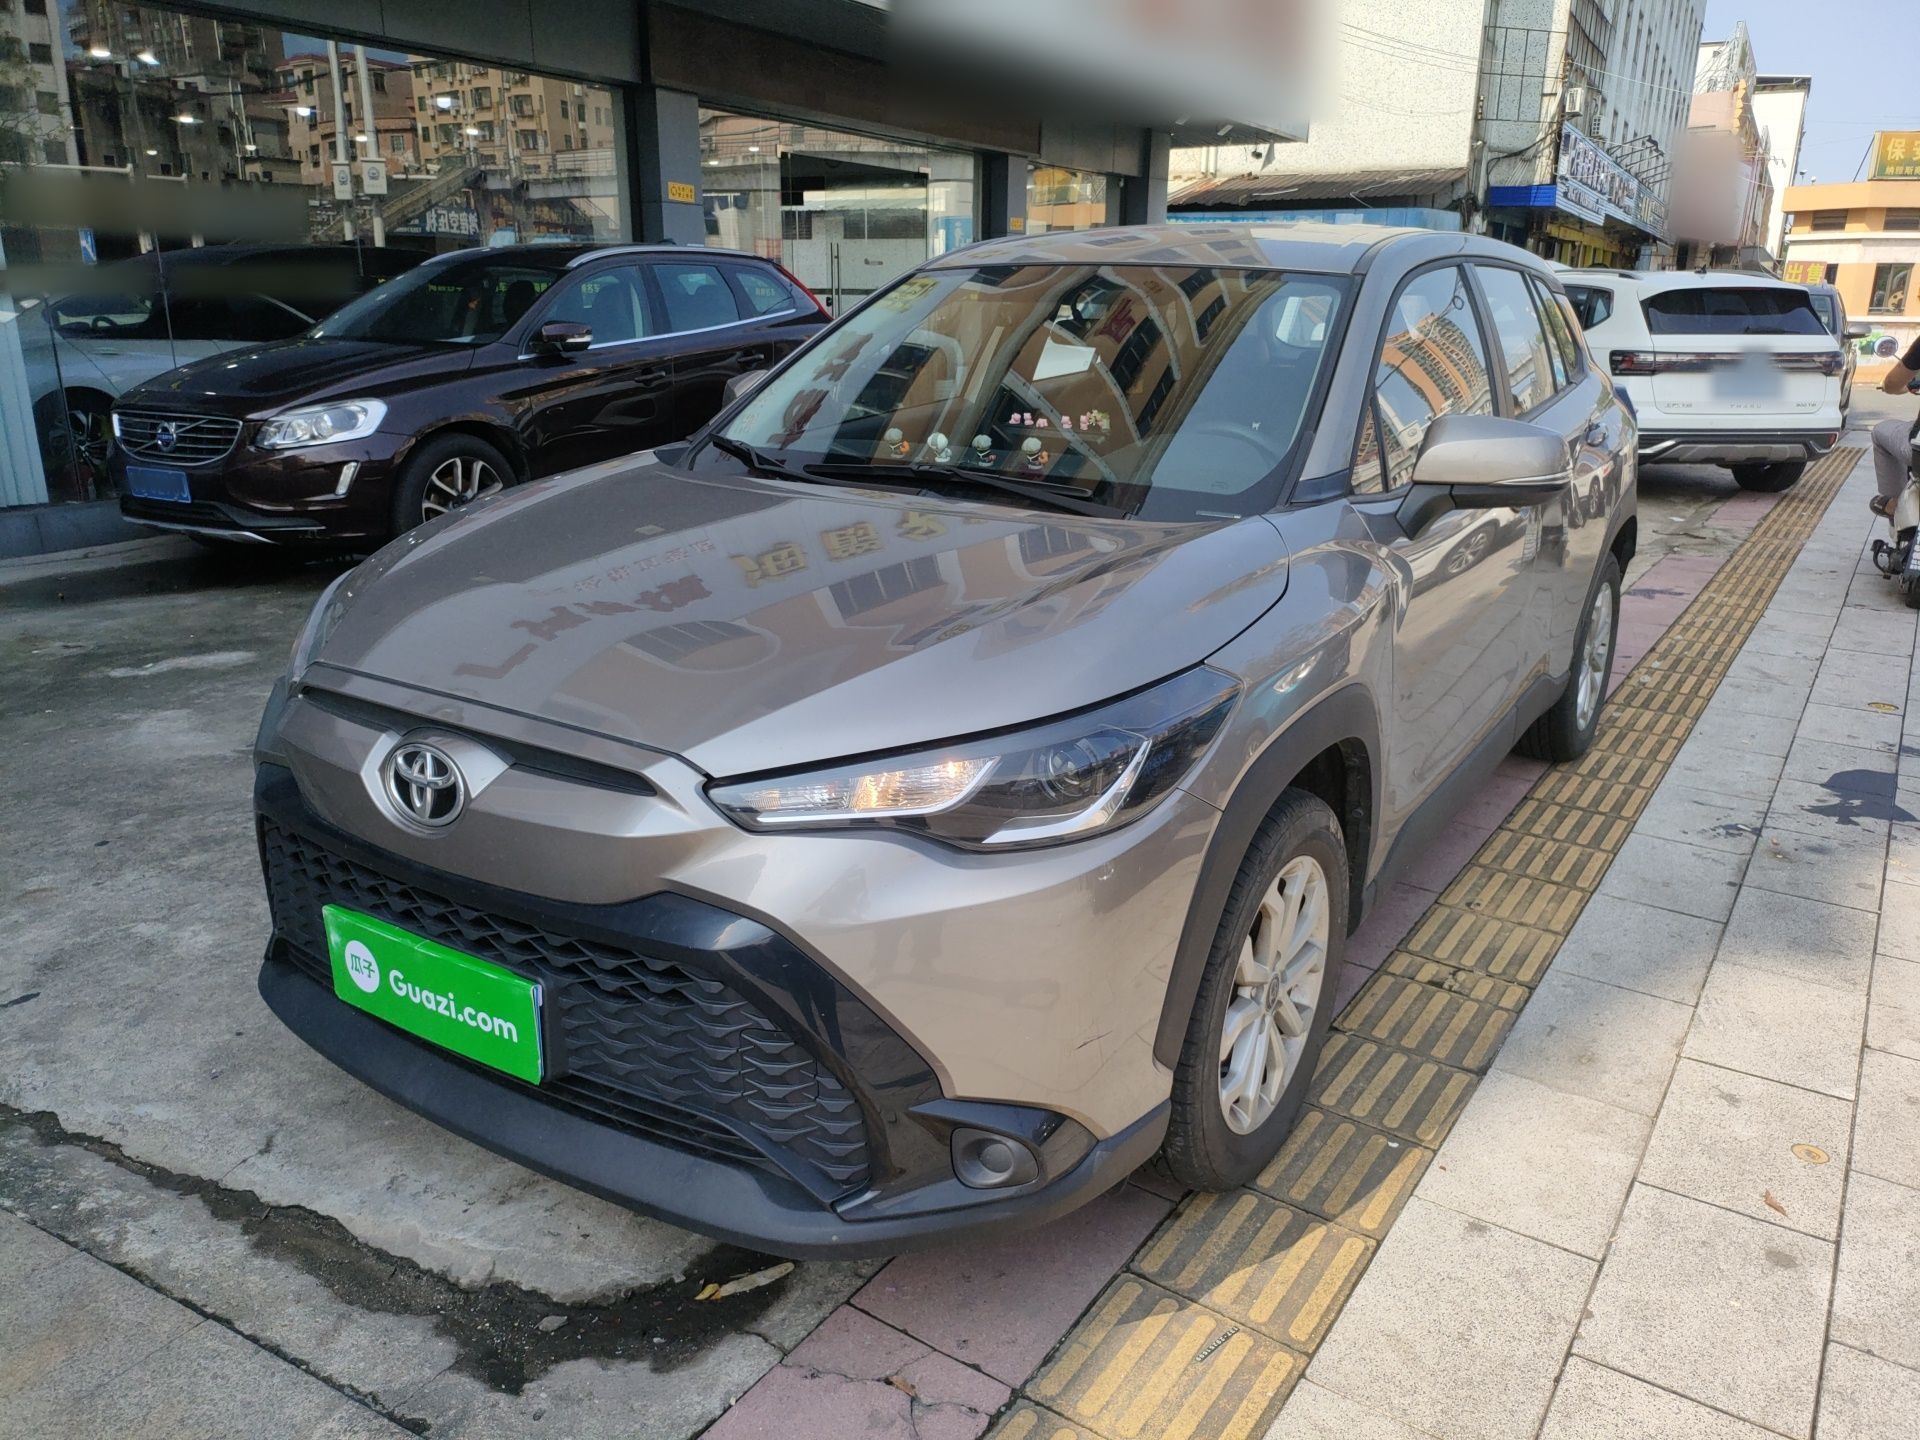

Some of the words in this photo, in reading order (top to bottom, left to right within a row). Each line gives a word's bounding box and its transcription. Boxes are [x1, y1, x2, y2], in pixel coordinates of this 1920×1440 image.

[1785, 262, 1825, 286] 出售
[350, 952, 376, 979] 瓜子
[389, 969, 518, 1043] Guazi.com
